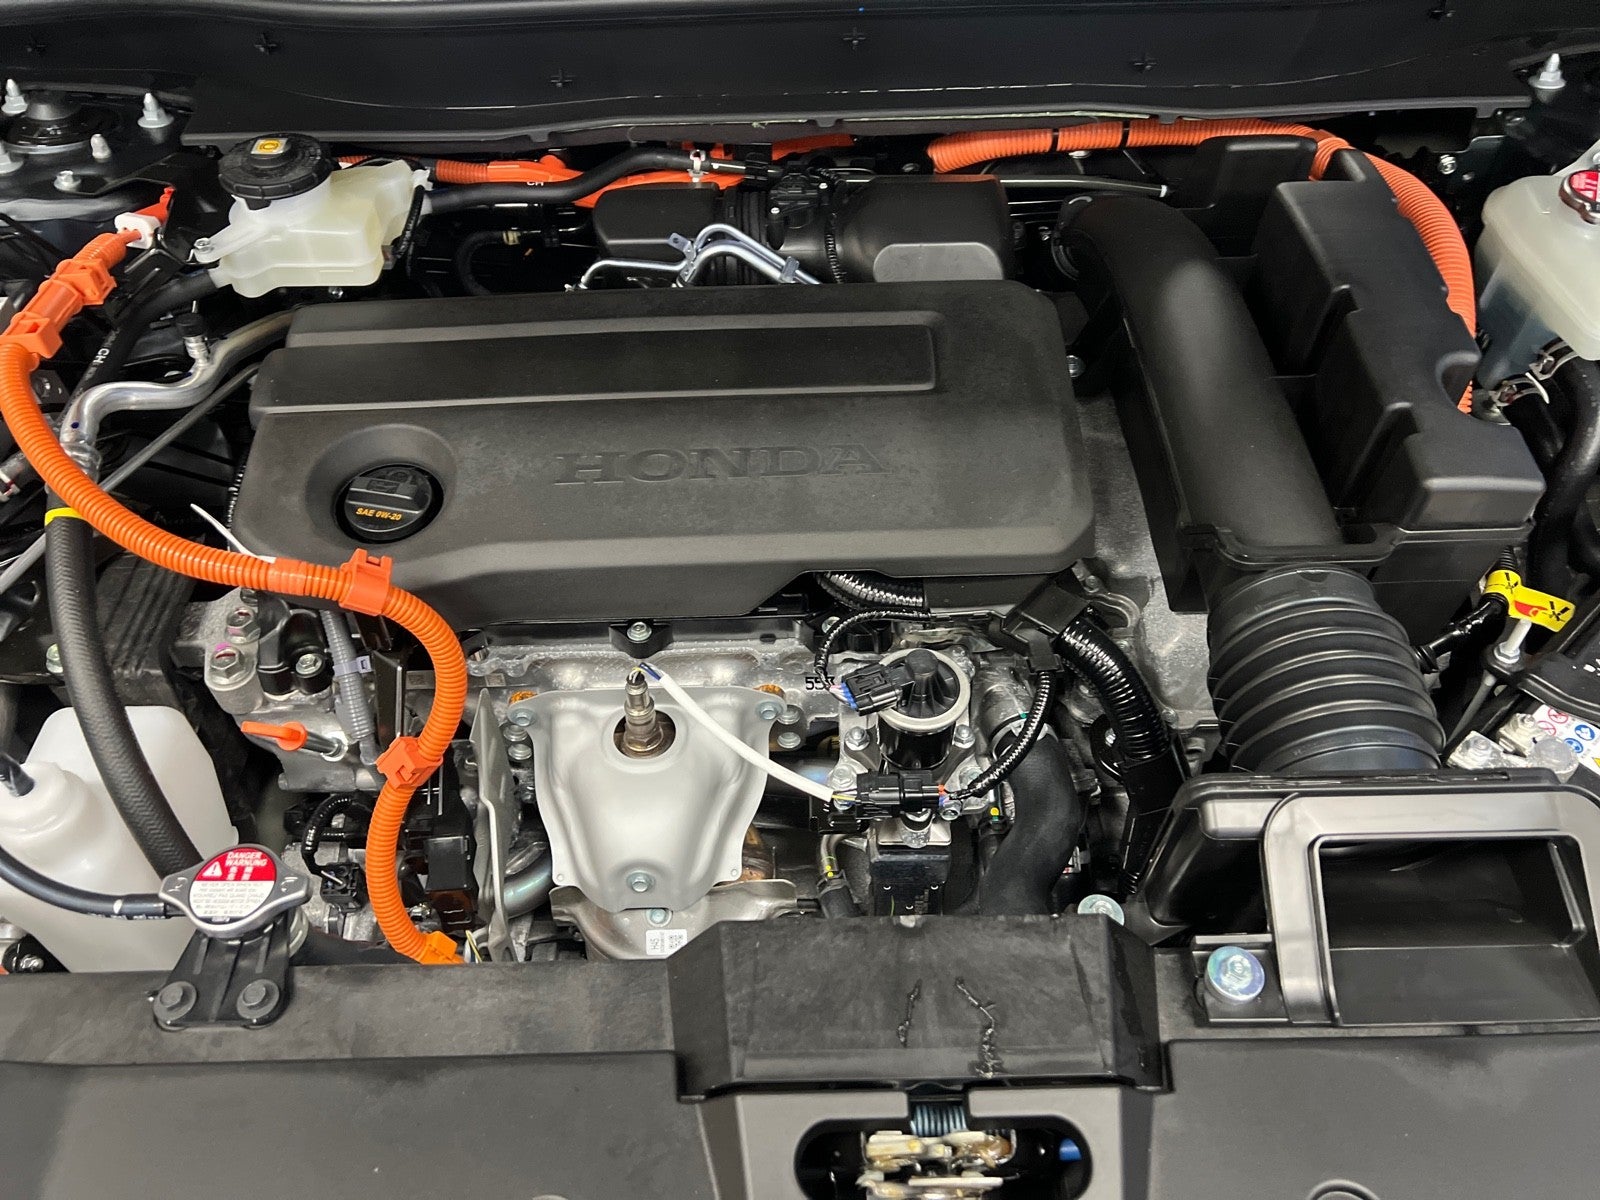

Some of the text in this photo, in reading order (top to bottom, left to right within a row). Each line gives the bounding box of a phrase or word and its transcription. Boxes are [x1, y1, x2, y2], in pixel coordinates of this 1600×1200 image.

[552, 443, 894, 486] HONDA
[355, 507, 403, 521] SAE 0W-20
[227, 851, 262, 860] DANGER
